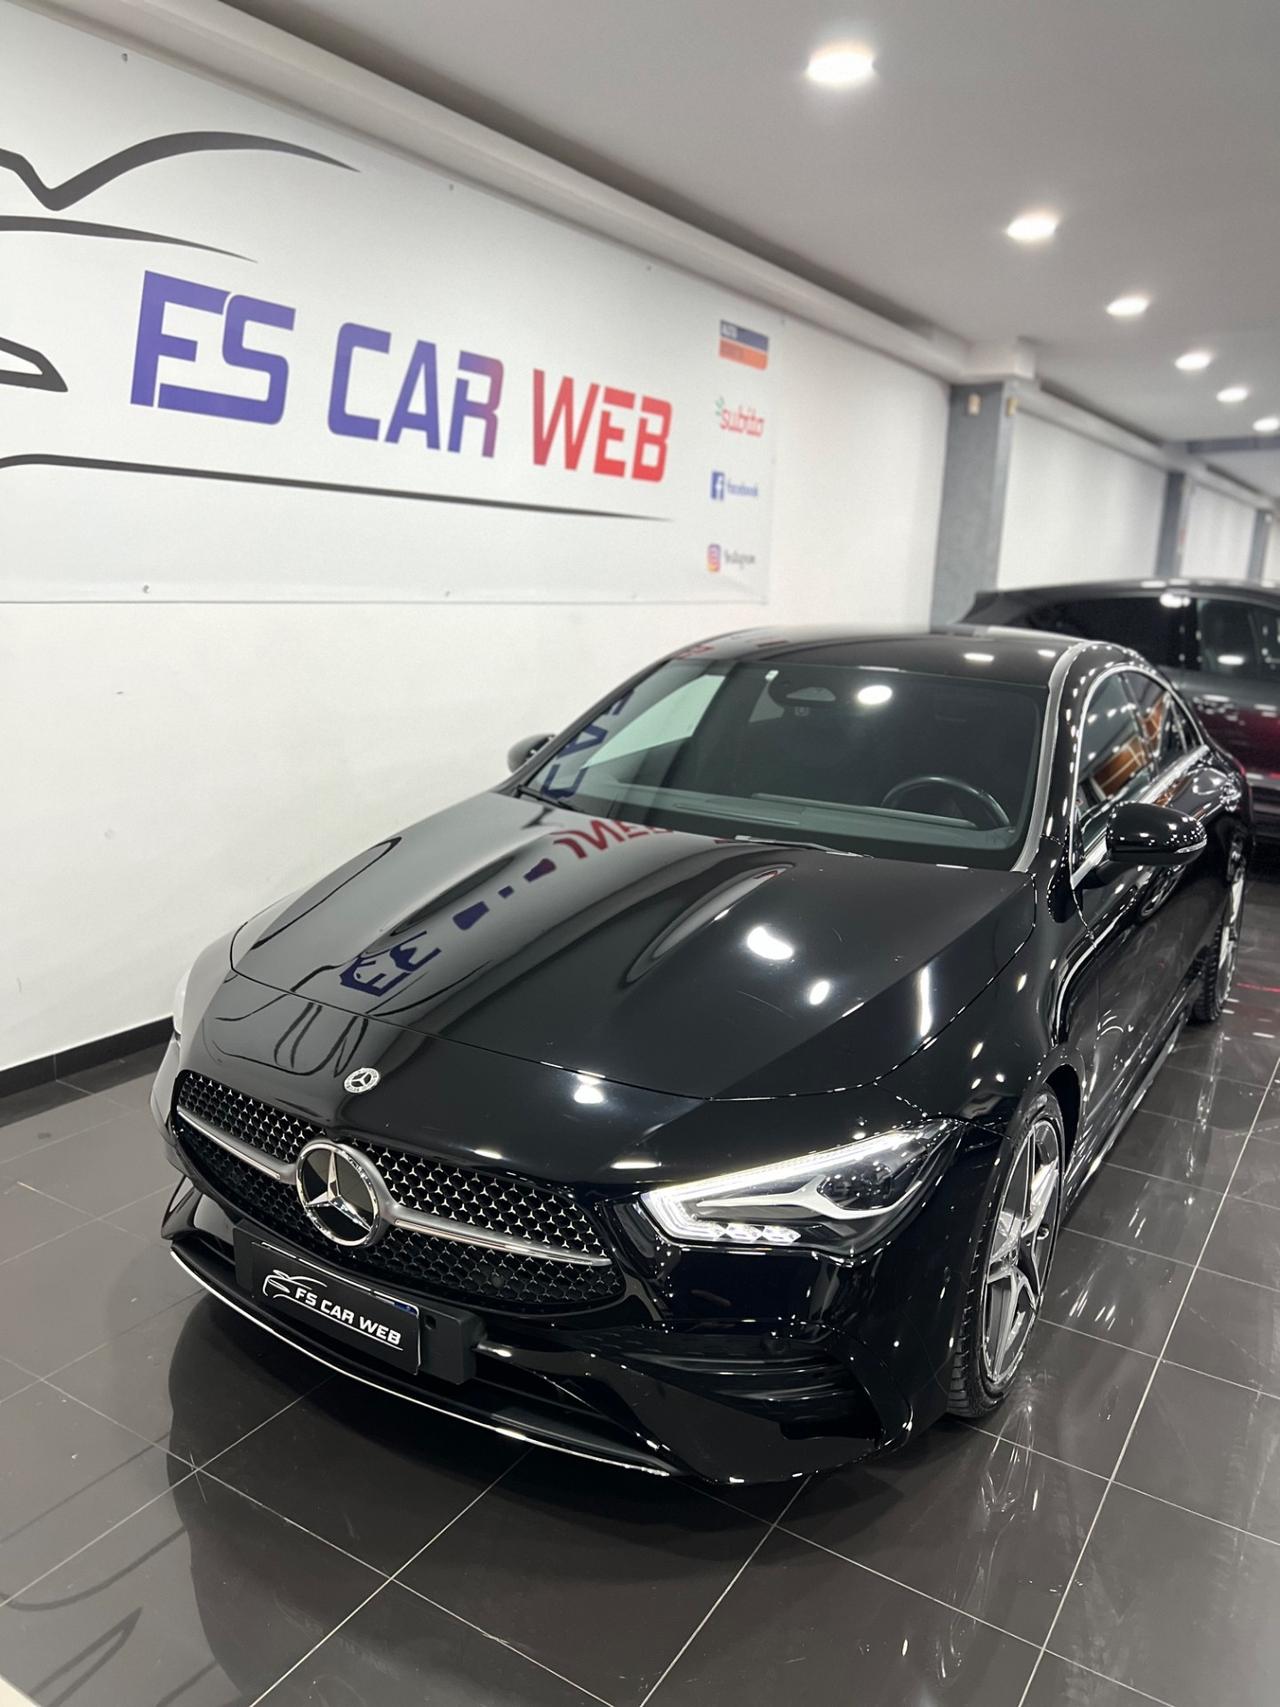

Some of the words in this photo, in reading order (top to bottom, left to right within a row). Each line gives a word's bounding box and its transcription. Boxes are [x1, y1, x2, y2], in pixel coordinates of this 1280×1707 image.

[328, 322, 504, 458] CAR
[533, 368, 672, 483] WEB
[295, 1288, 317, 1306] FS
[320, 1300, 355, 1325] CAR
[359, 1316, 402, 1346] WEB
